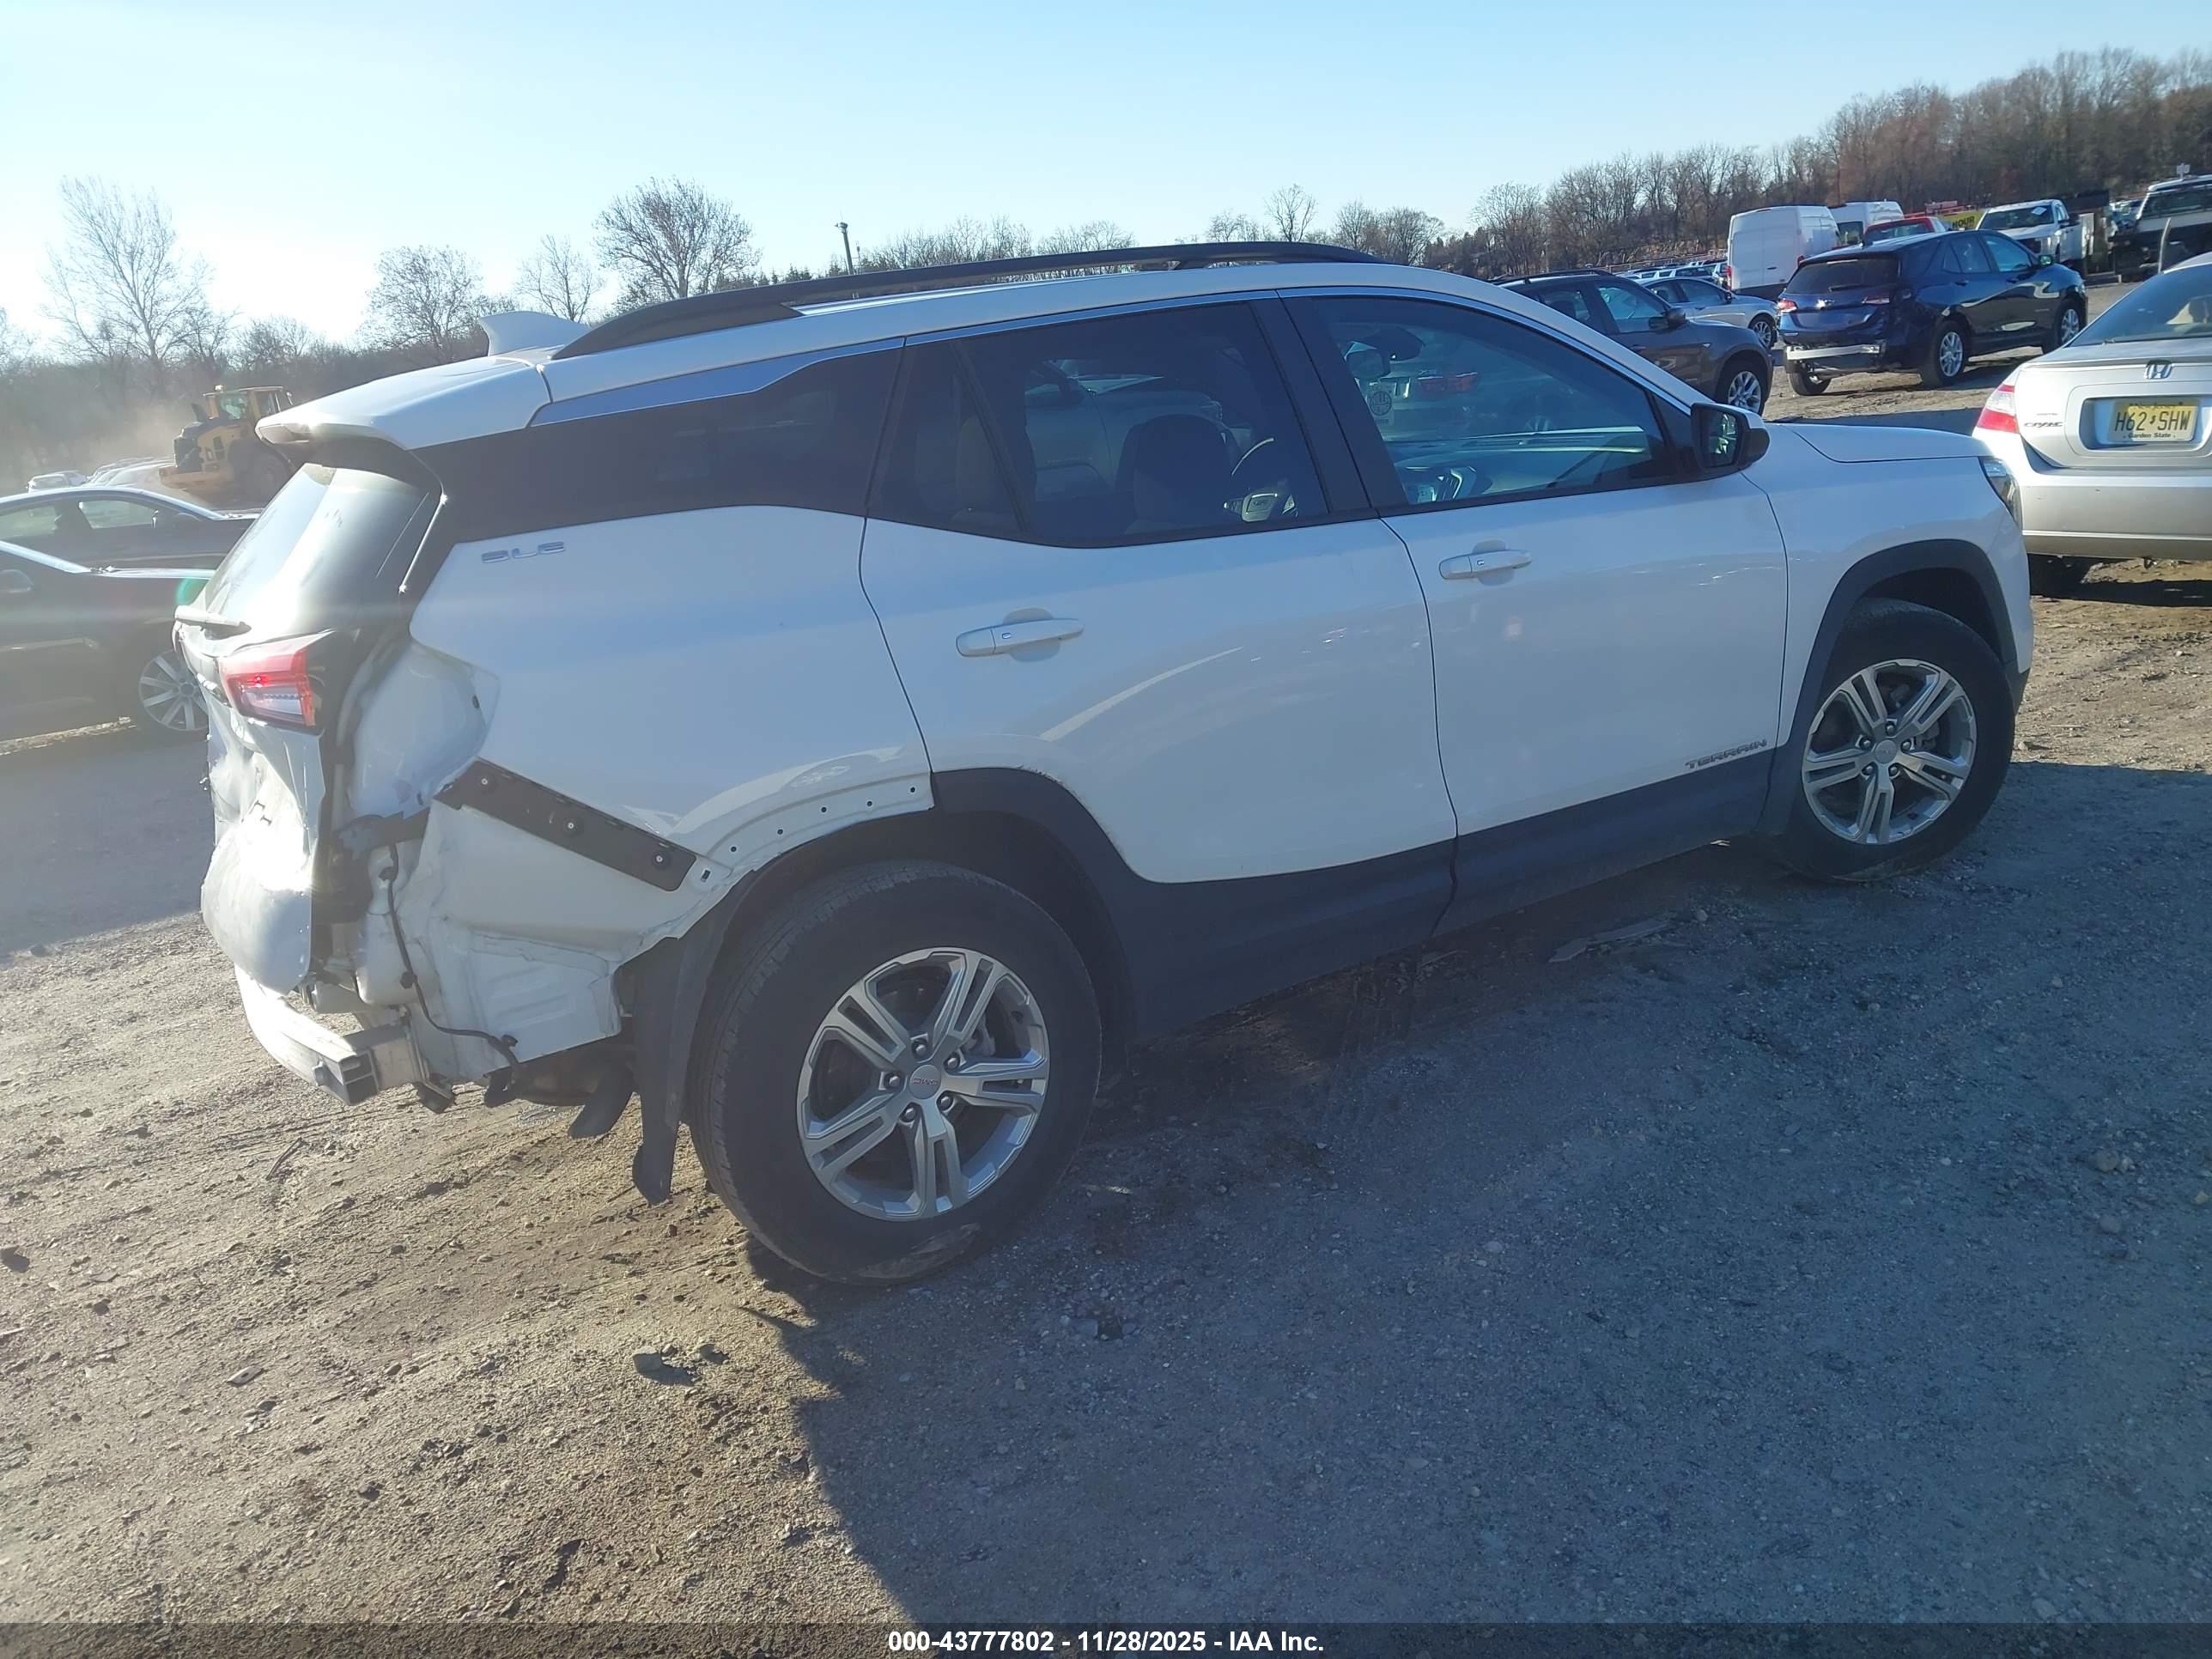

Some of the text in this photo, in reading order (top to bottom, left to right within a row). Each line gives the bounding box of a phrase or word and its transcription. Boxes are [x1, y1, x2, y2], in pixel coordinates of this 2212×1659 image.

[1952, 216, 1976, 229] HOUR
[2114, 410, 2192, 432] H62 SHW
[481, 541, 566, 564] SLE
[1684, 738, 1767, 769] TERRAIN
